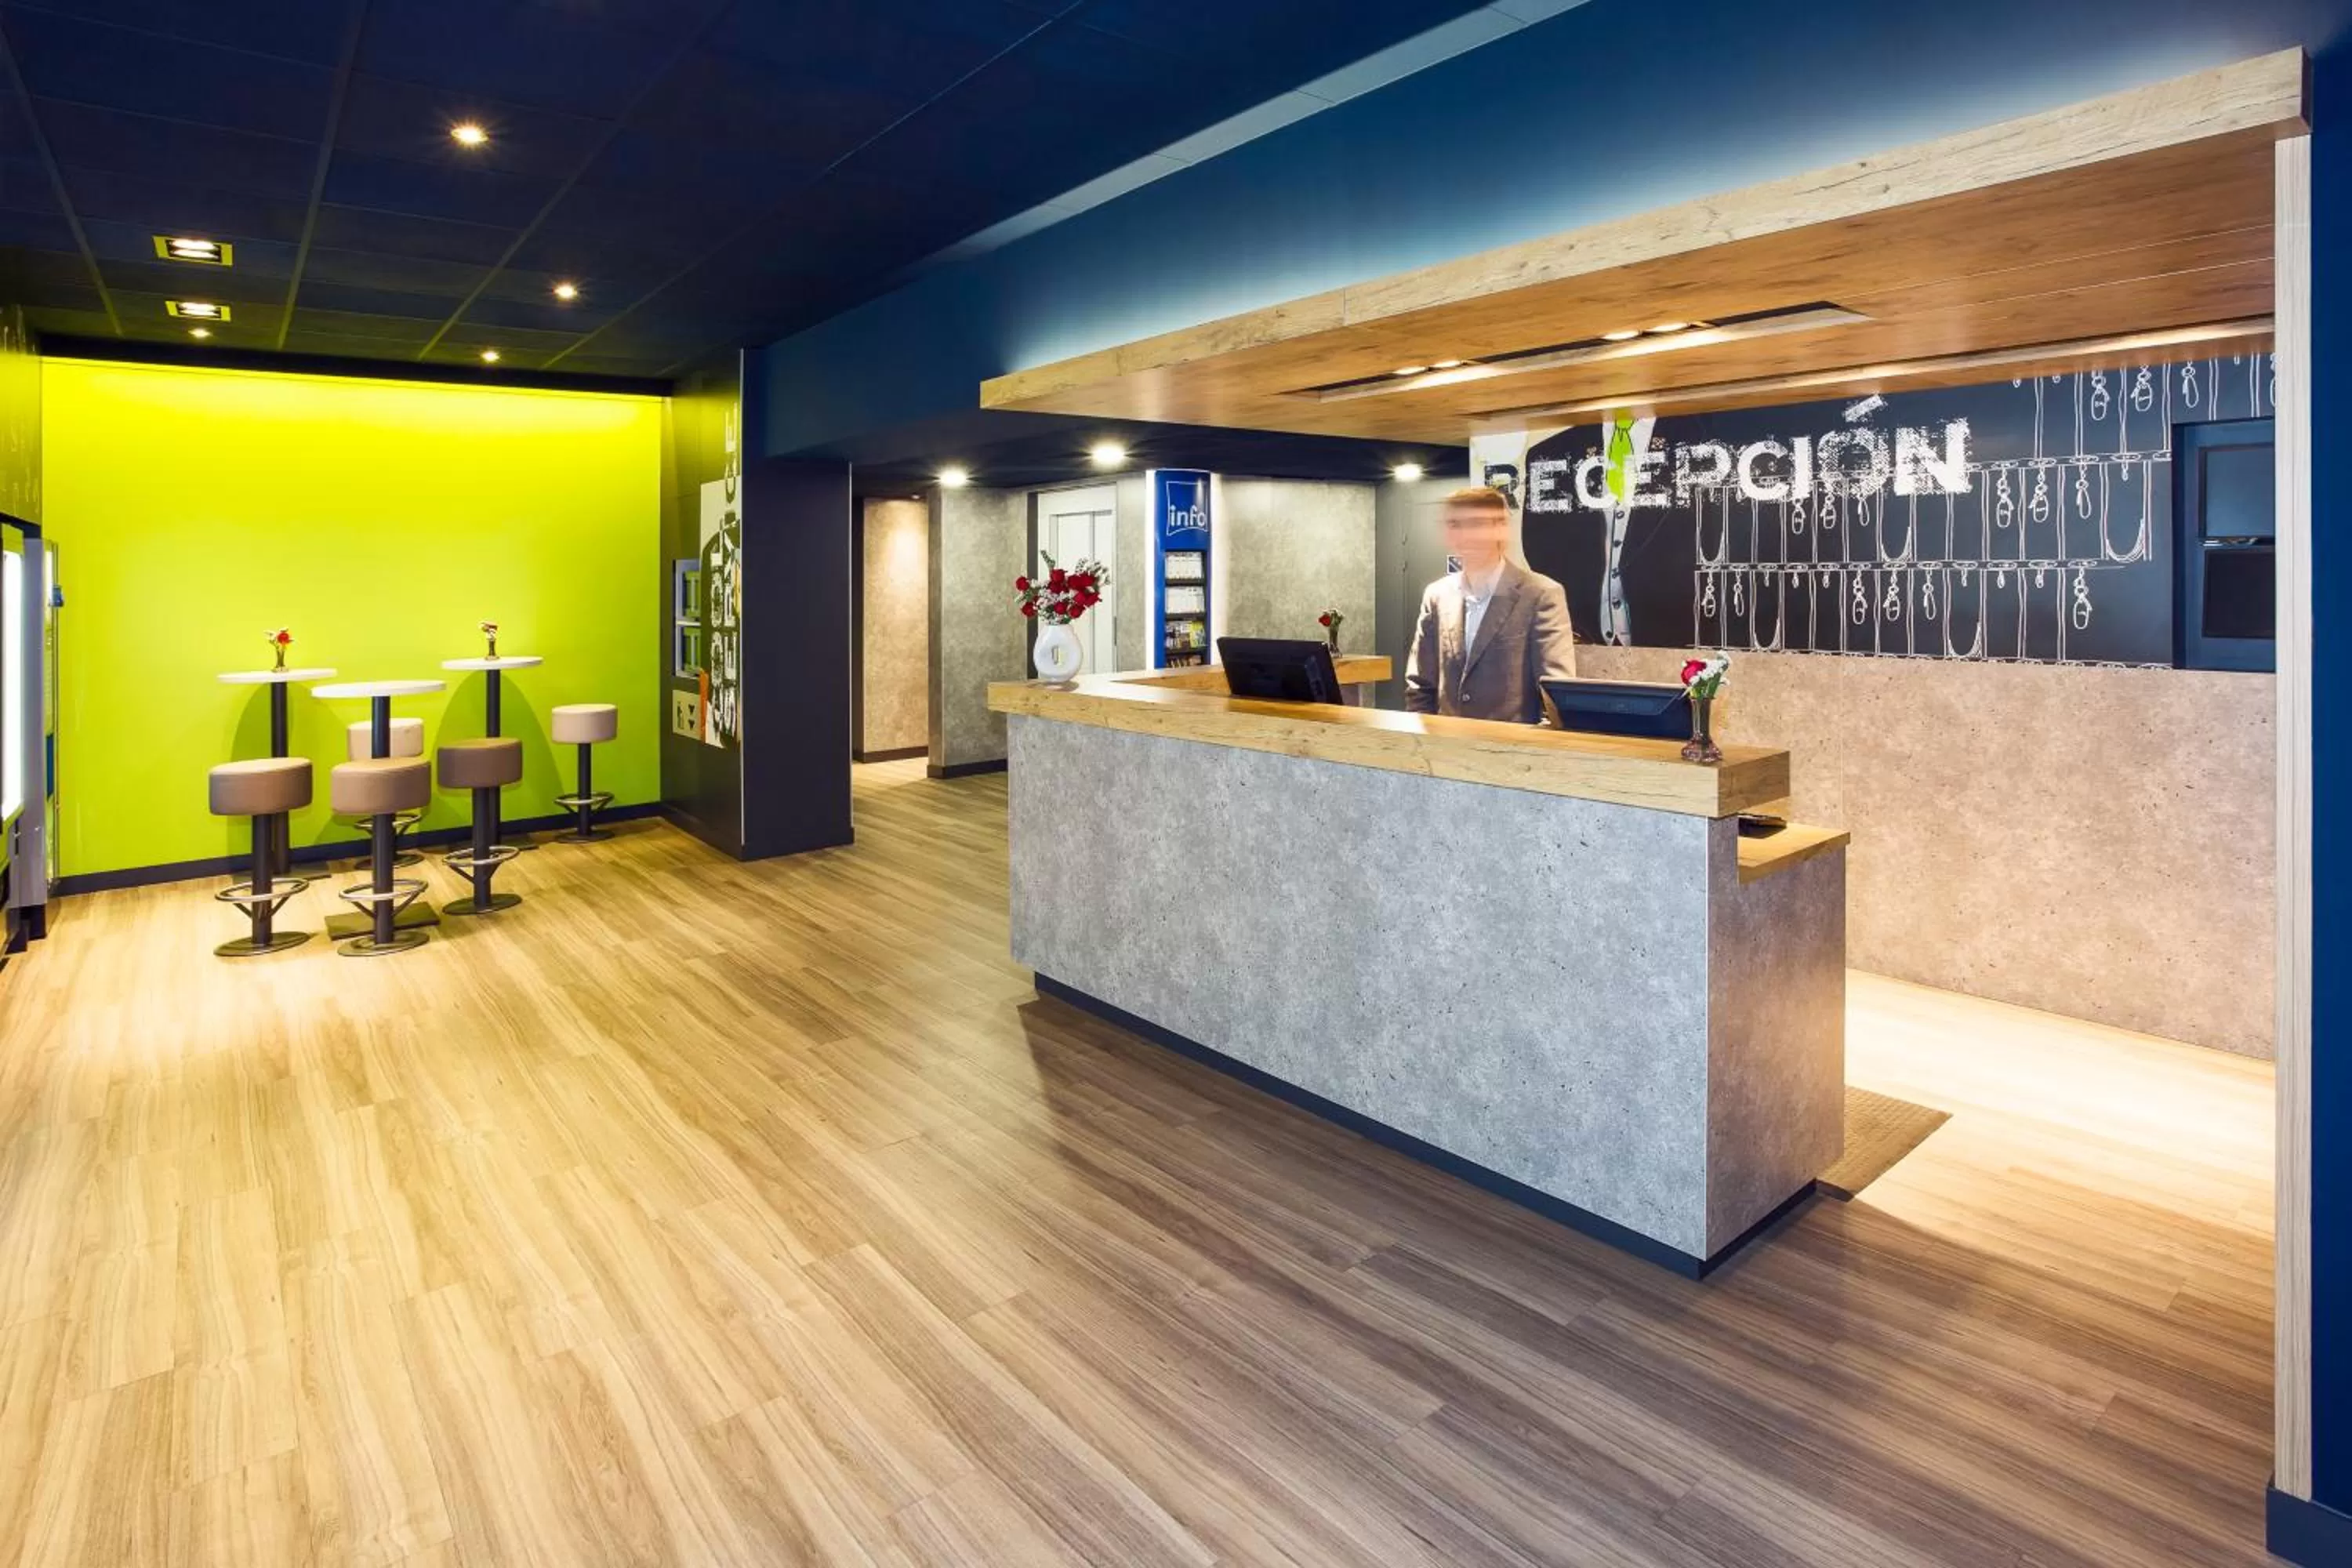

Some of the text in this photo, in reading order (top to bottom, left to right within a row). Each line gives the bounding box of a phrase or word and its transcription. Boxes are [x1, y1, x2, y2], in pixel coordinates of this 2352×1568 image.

[1170, 504, 1206, 526] info
[1484, 393, 1973, 514] RECEPCIÓN
[710, 518, 724, 735] COOL
[724, 401, 737, 738] SERVICE
